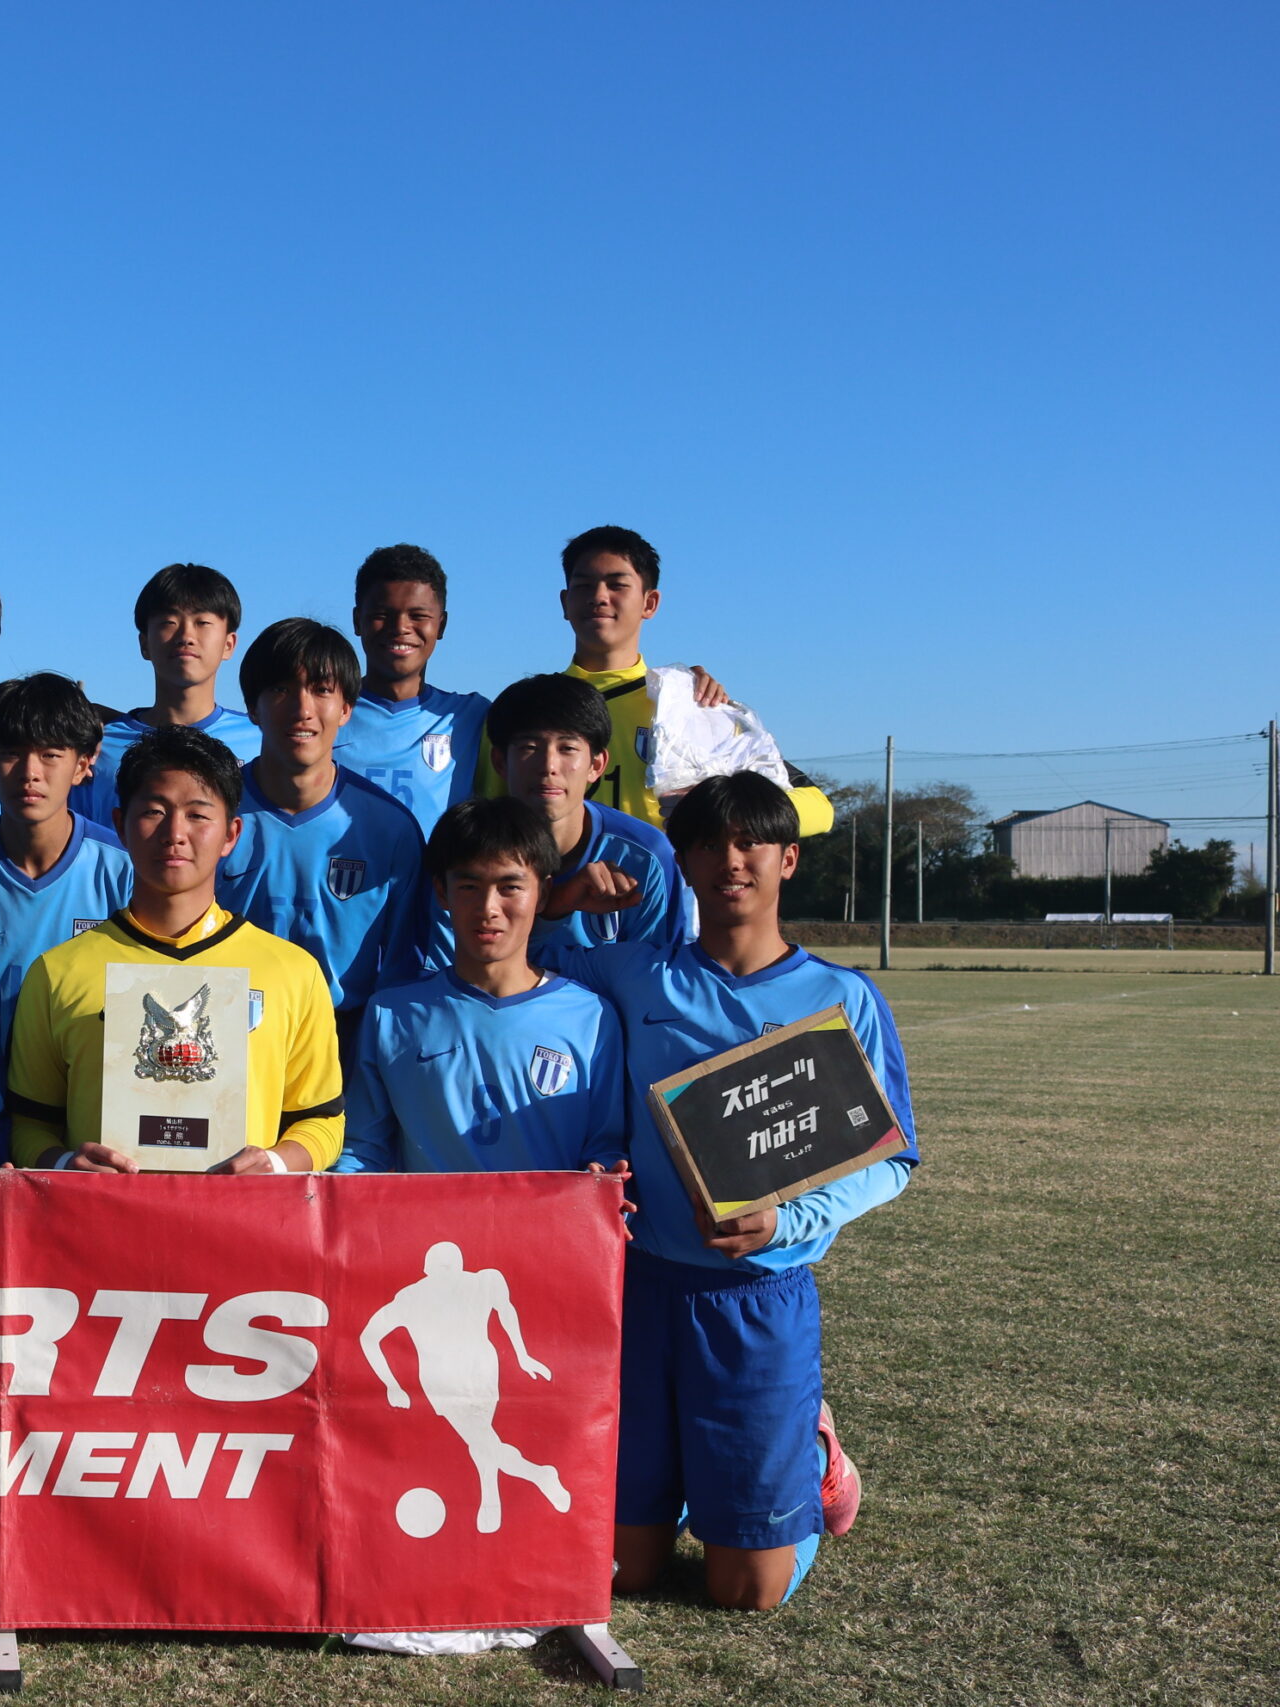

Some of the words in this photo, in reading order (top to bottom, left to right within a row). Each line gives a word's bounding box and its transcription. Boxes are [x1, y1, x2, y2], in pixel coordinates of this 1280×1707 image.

[538, 1049, 560, 1062] TOKO
[721, 1057, 816, 1118] スポーツ
[762, 1100, 794, 1116] するなら
[747, 1105, 820, 1160] かみす
